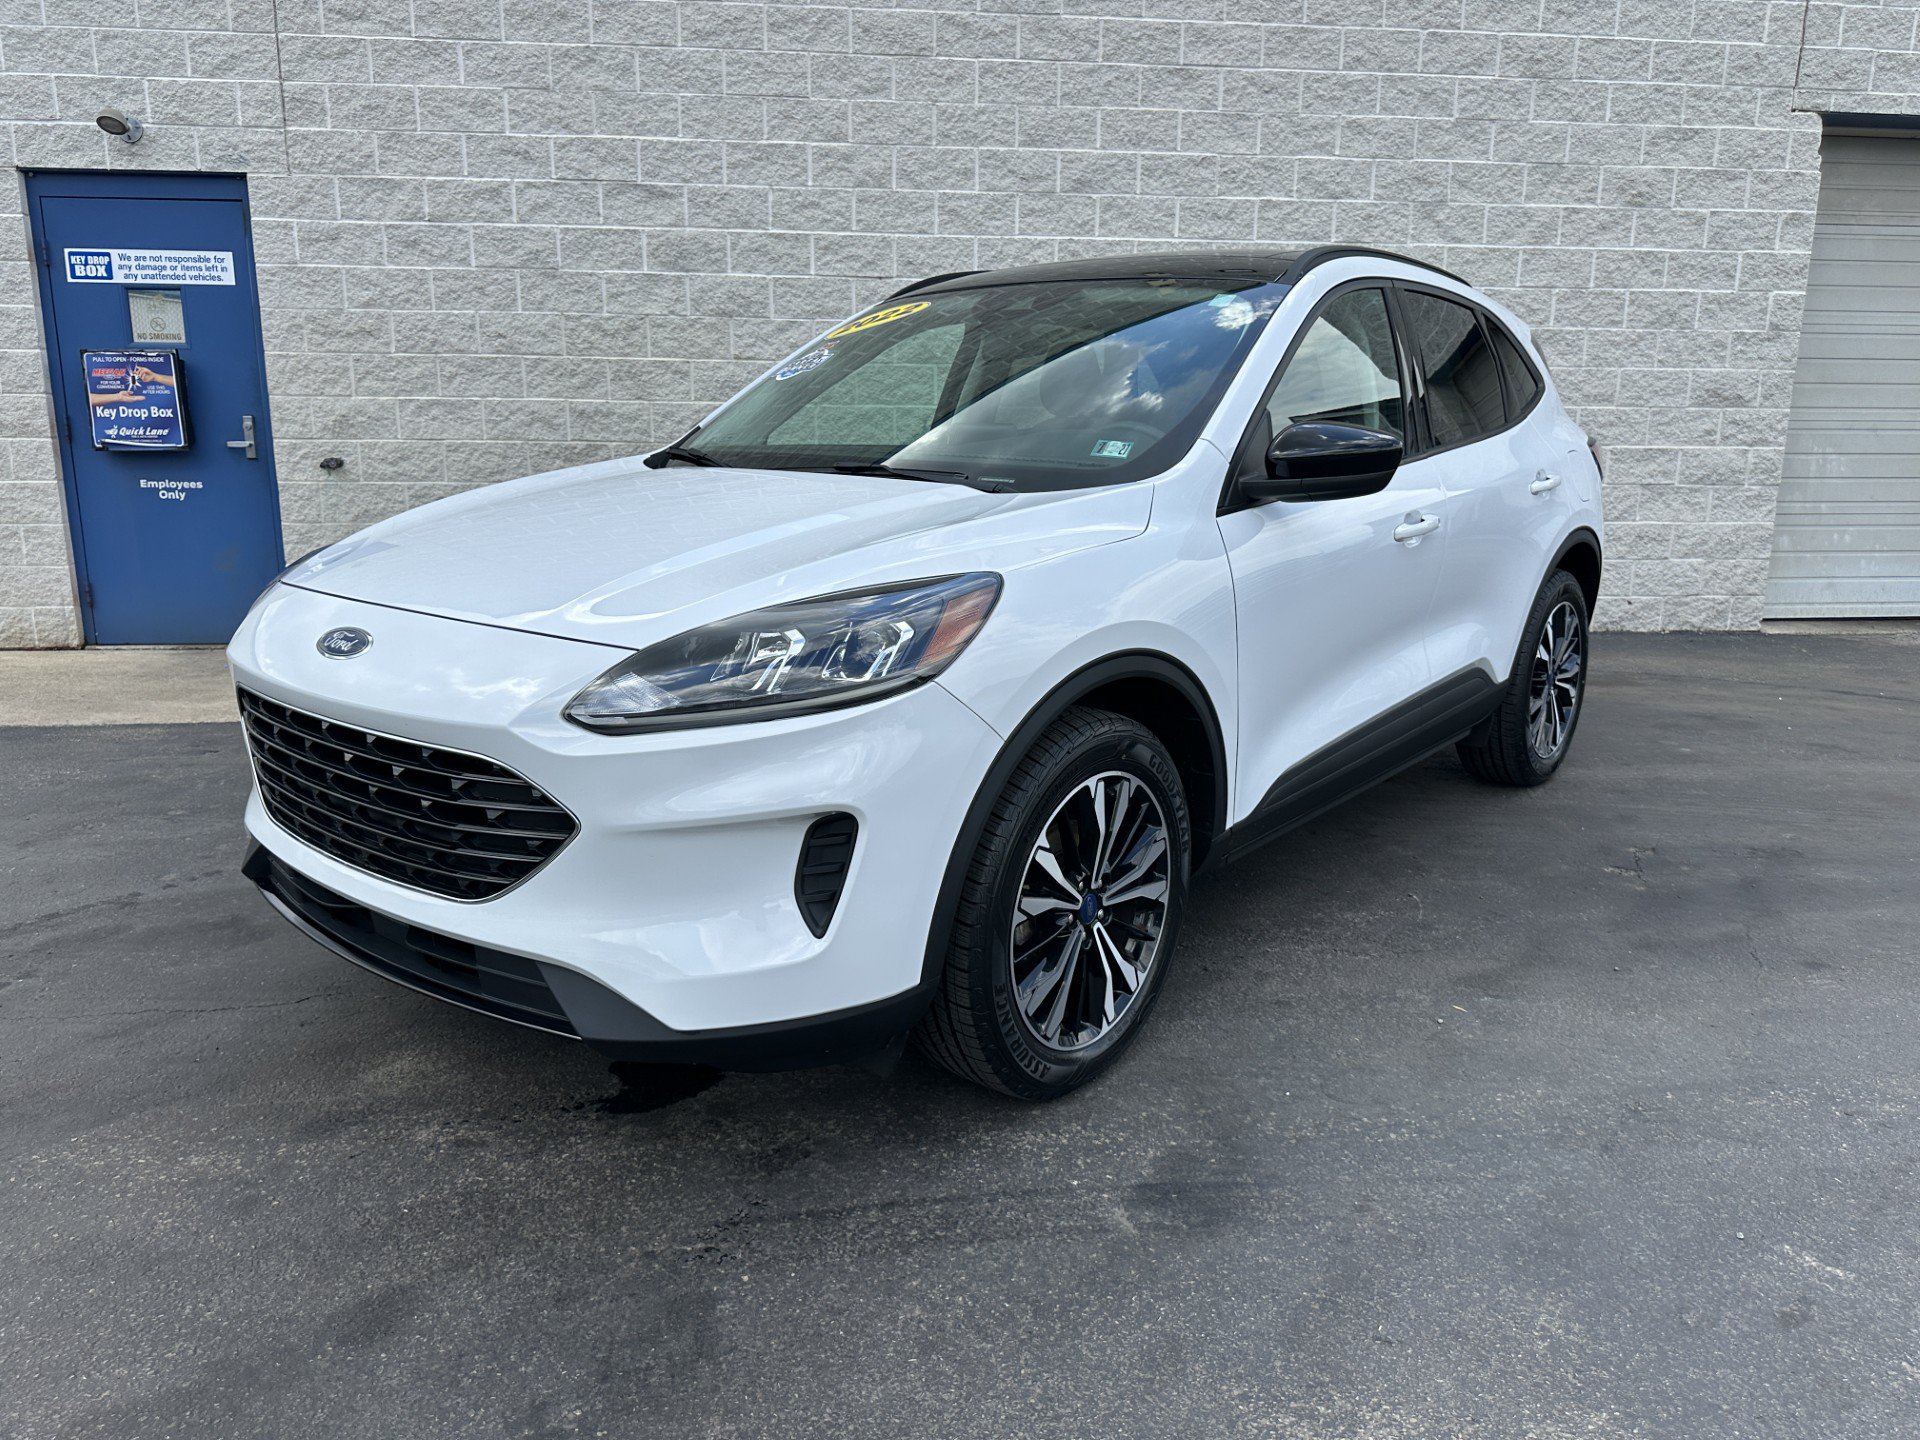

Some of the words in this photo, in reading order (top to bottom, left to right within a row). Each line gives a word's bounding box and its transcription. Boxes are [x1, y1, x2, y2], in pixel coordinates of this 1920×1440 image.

[70, 255, 87, 265] KEY
[87, 256, 109, 266] DROP
[118, 253, 132, 262] We
[150, 254, 163, 263] not
[164, 254, 211, 265] responsible
[213, 255, 226, 264] for
[74, 265, 108, 277] BOX
[118, 264, 132, 272] any
[135, 263, 167, 272] damage
[170, 264, 178, 272] or
[180, 264, 203, 272] items
[204, 264, 219, 272] left
[220, 264, 228, 273] in
[123, 273, 138, 282] any
[141, 271, 187, 281] unattended
[188, 272, 224, 282] vehicles.
[137, 332, 148, 340] NO
[149, 332, 182, 341] SMOKING
[96, 405, 117, 420] Key
[119, 406, 149, 420] Drop
[150, 406, 174, 418] Box
[119, 427, 146, 436] Quick
[146, 427, 170, 436] Lane
[140, 479, 203, 490] Employees
[159, 490, 186, 501] Only
[324, 630, 359, 652] Ford
[1149, 753, 1190, 853] GOODYEAR
[994, 983, 1052, 1079] ASSURANCE
